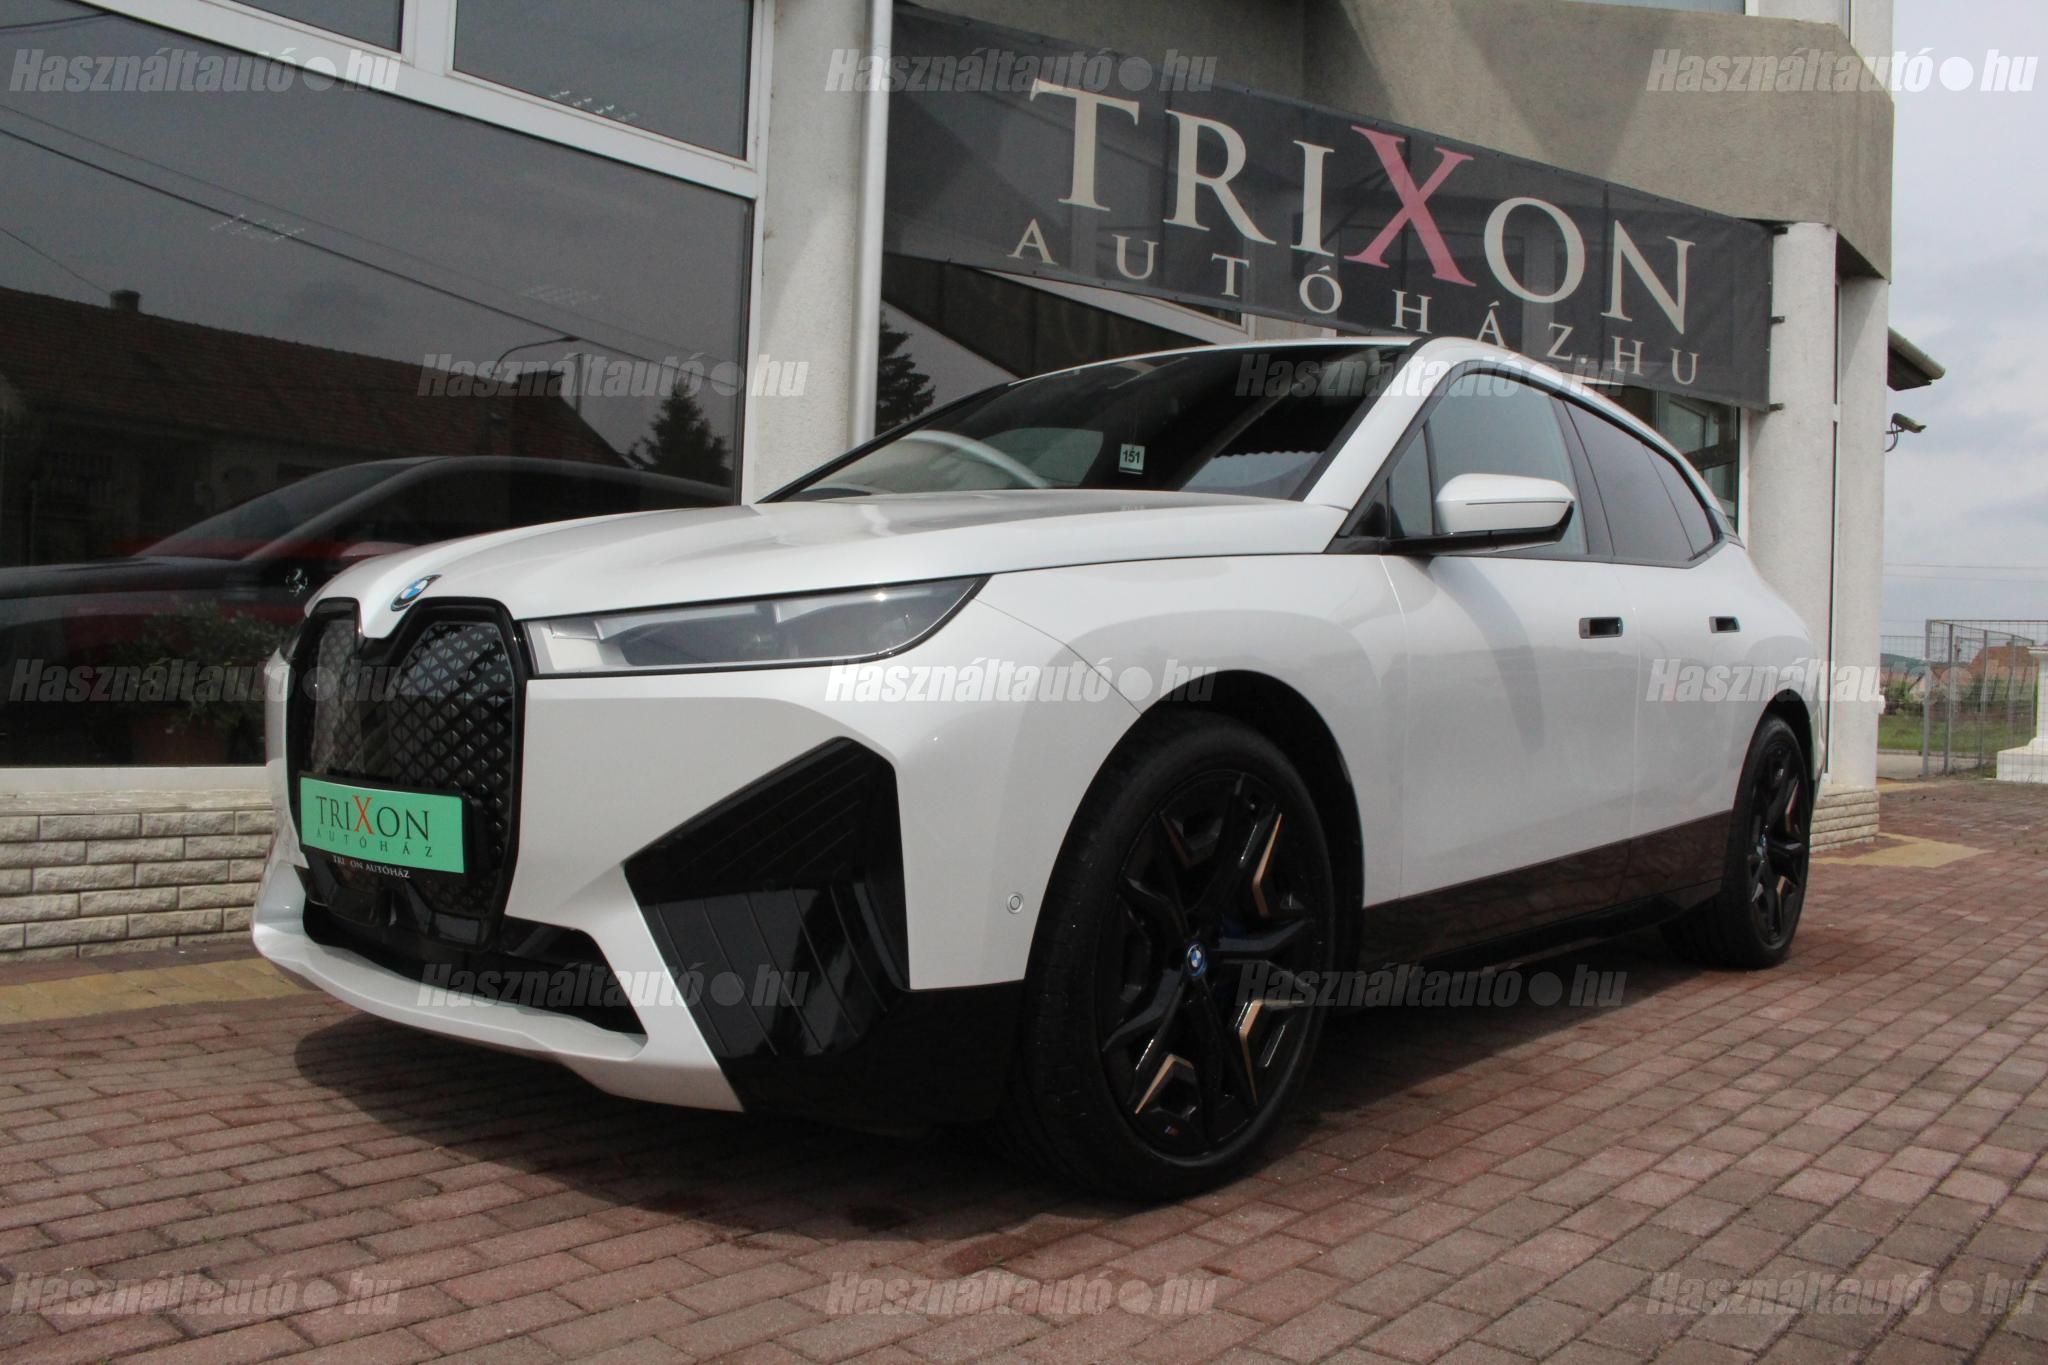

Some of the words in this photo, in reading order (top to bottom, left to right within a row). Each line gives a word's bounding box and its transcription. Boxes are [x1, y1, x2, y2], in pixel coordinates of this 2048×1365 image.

[1028, 77, 1697, 335] TRIXON
[1122, 450, 1140, 464] 151
[315, 795, 430, 842] TRIXON
[316, 827, 433, 858] AUTÓHÁZ
